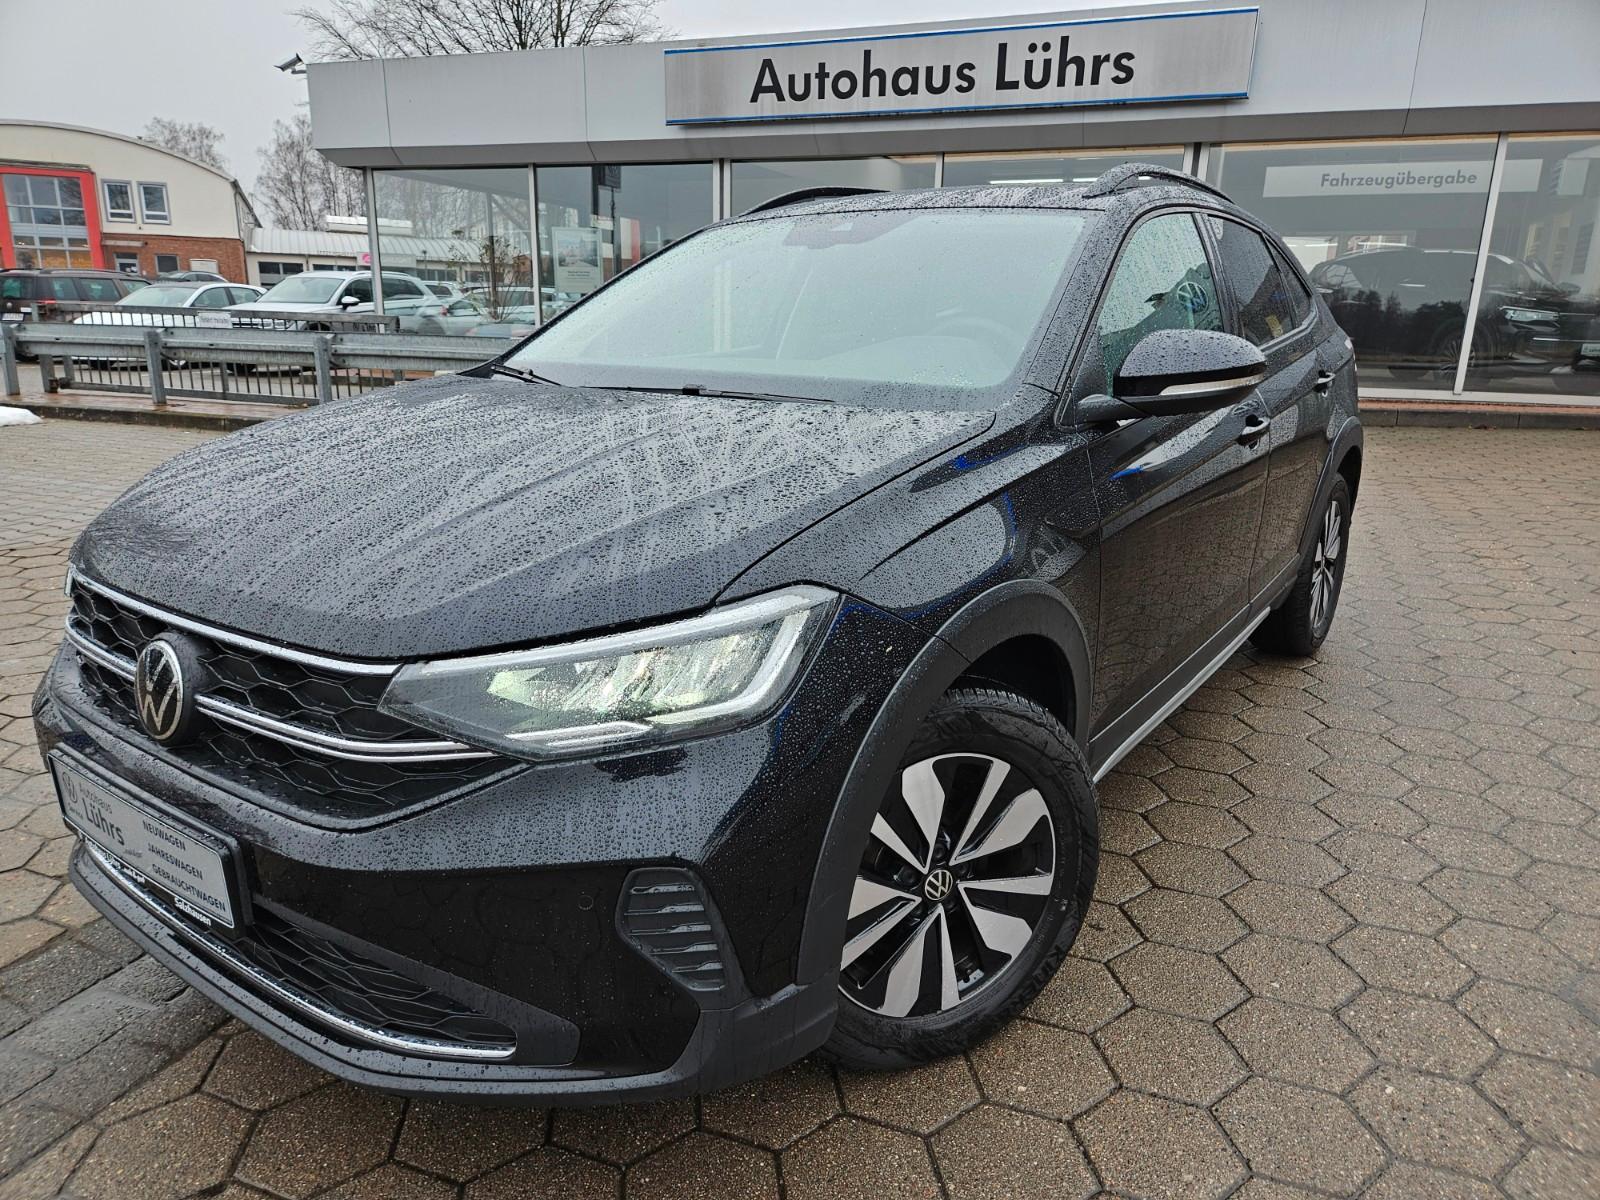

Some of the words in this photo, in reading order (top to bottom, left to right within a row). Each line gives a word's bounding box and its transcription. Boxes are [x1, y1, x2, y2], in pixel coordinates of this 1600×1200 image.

[749, 49, 976, 103] Autohaus
[995, 35, 1135, 92] Lührs
[1320, 169, 1478, 189] Fahrzeugübergabe
[81, 798, 125, 846] Lührs
[142, 820, 187, 851] NEUWAGEN
[147, 843, 204, 881] JAHRESWAGEN
[151, 863, 227, 913] GEBRAUCHTWAGEN
